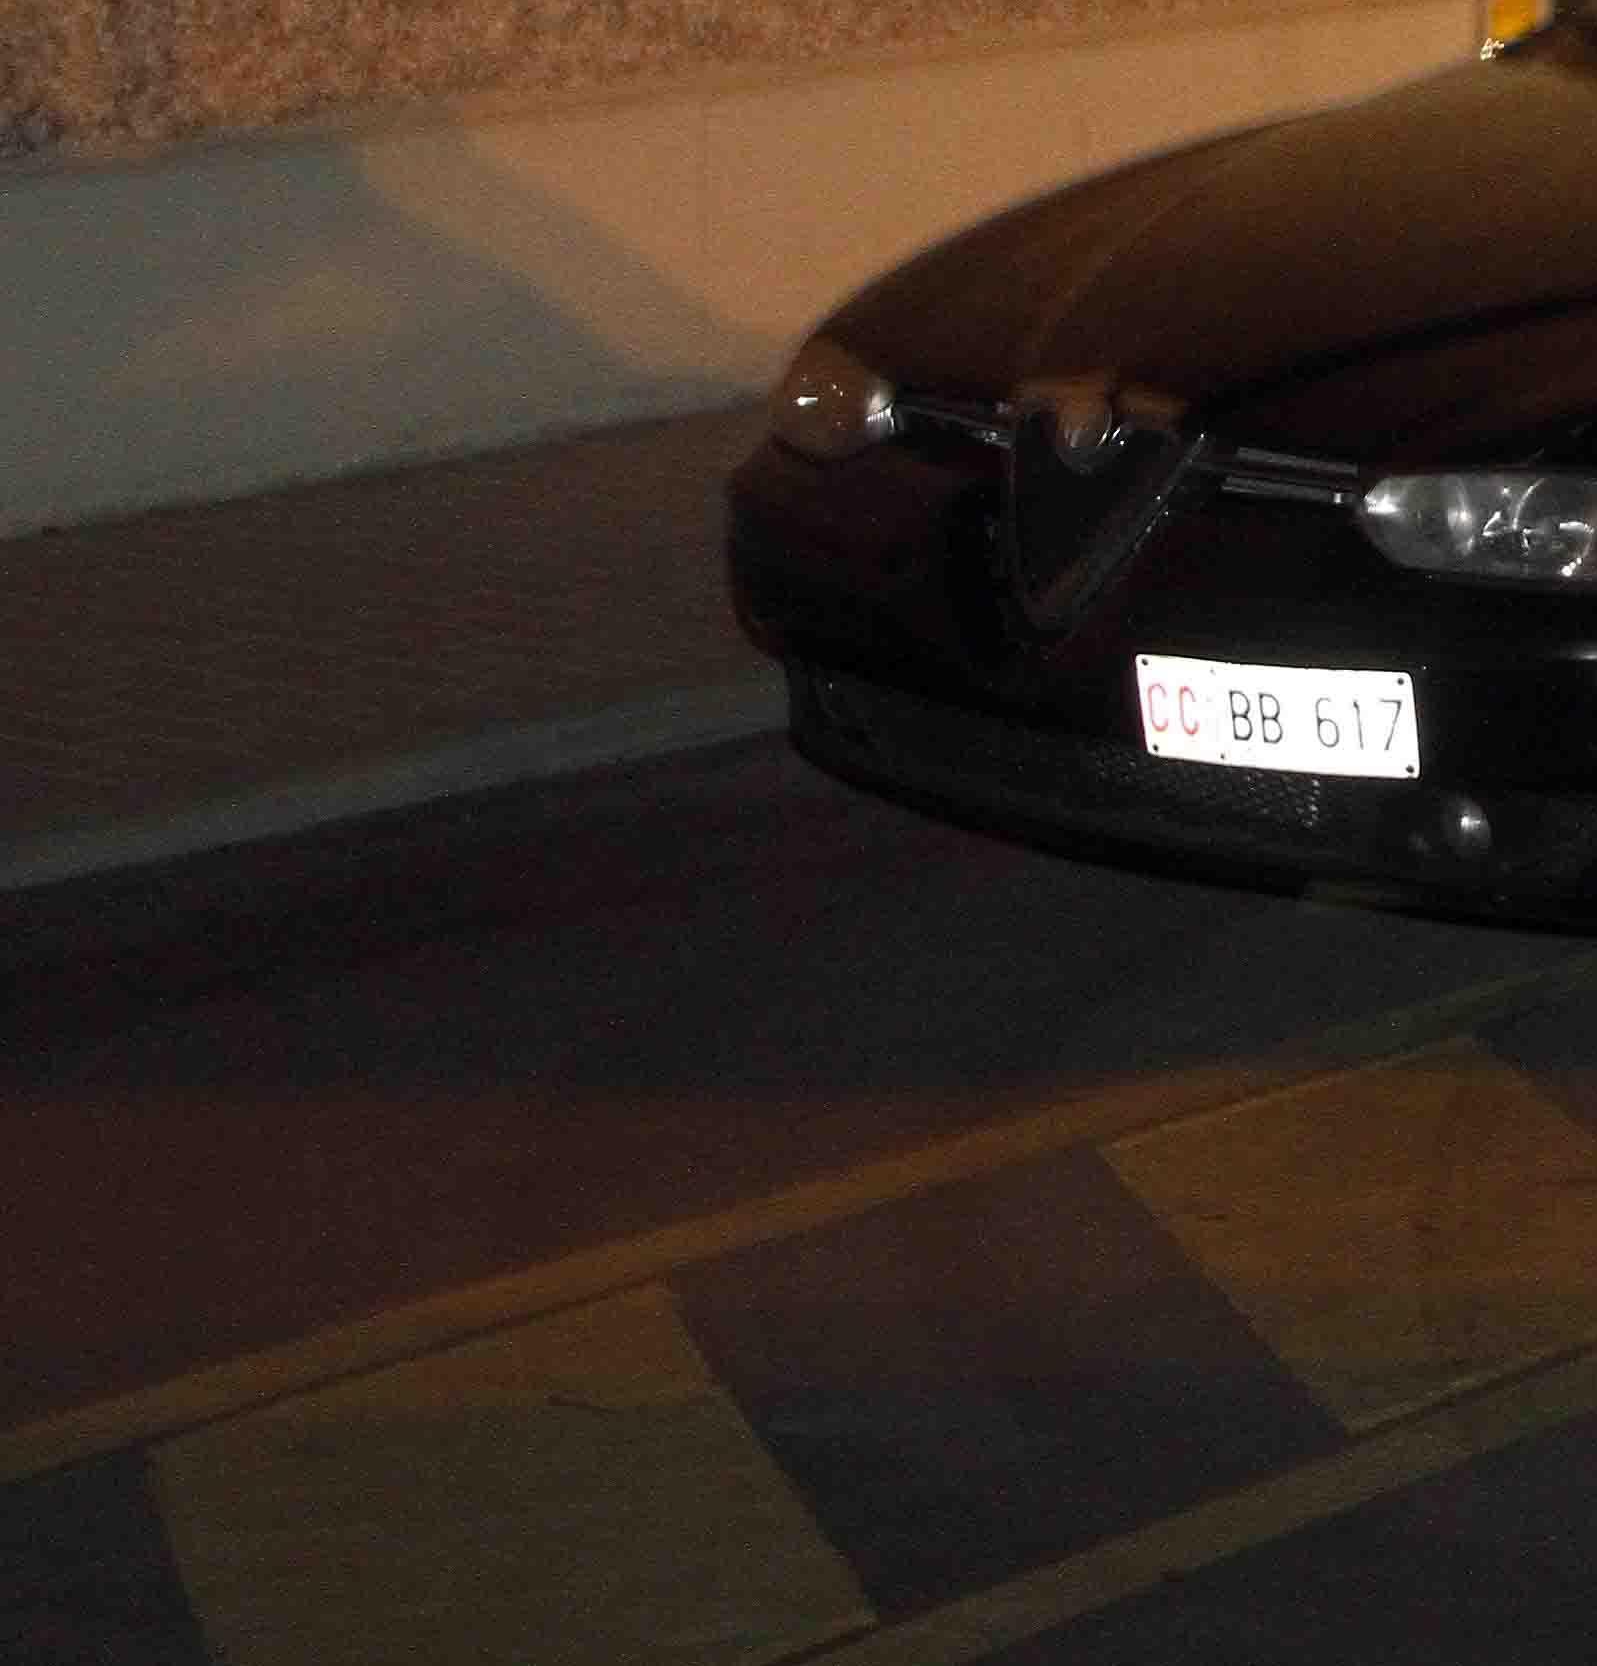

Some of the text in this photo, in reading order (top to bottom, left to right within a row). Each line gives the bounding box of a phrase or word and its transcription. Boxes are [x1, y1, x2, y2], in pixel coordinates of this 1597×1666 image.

[1147, 683, 1403, 751] CC BB 617
